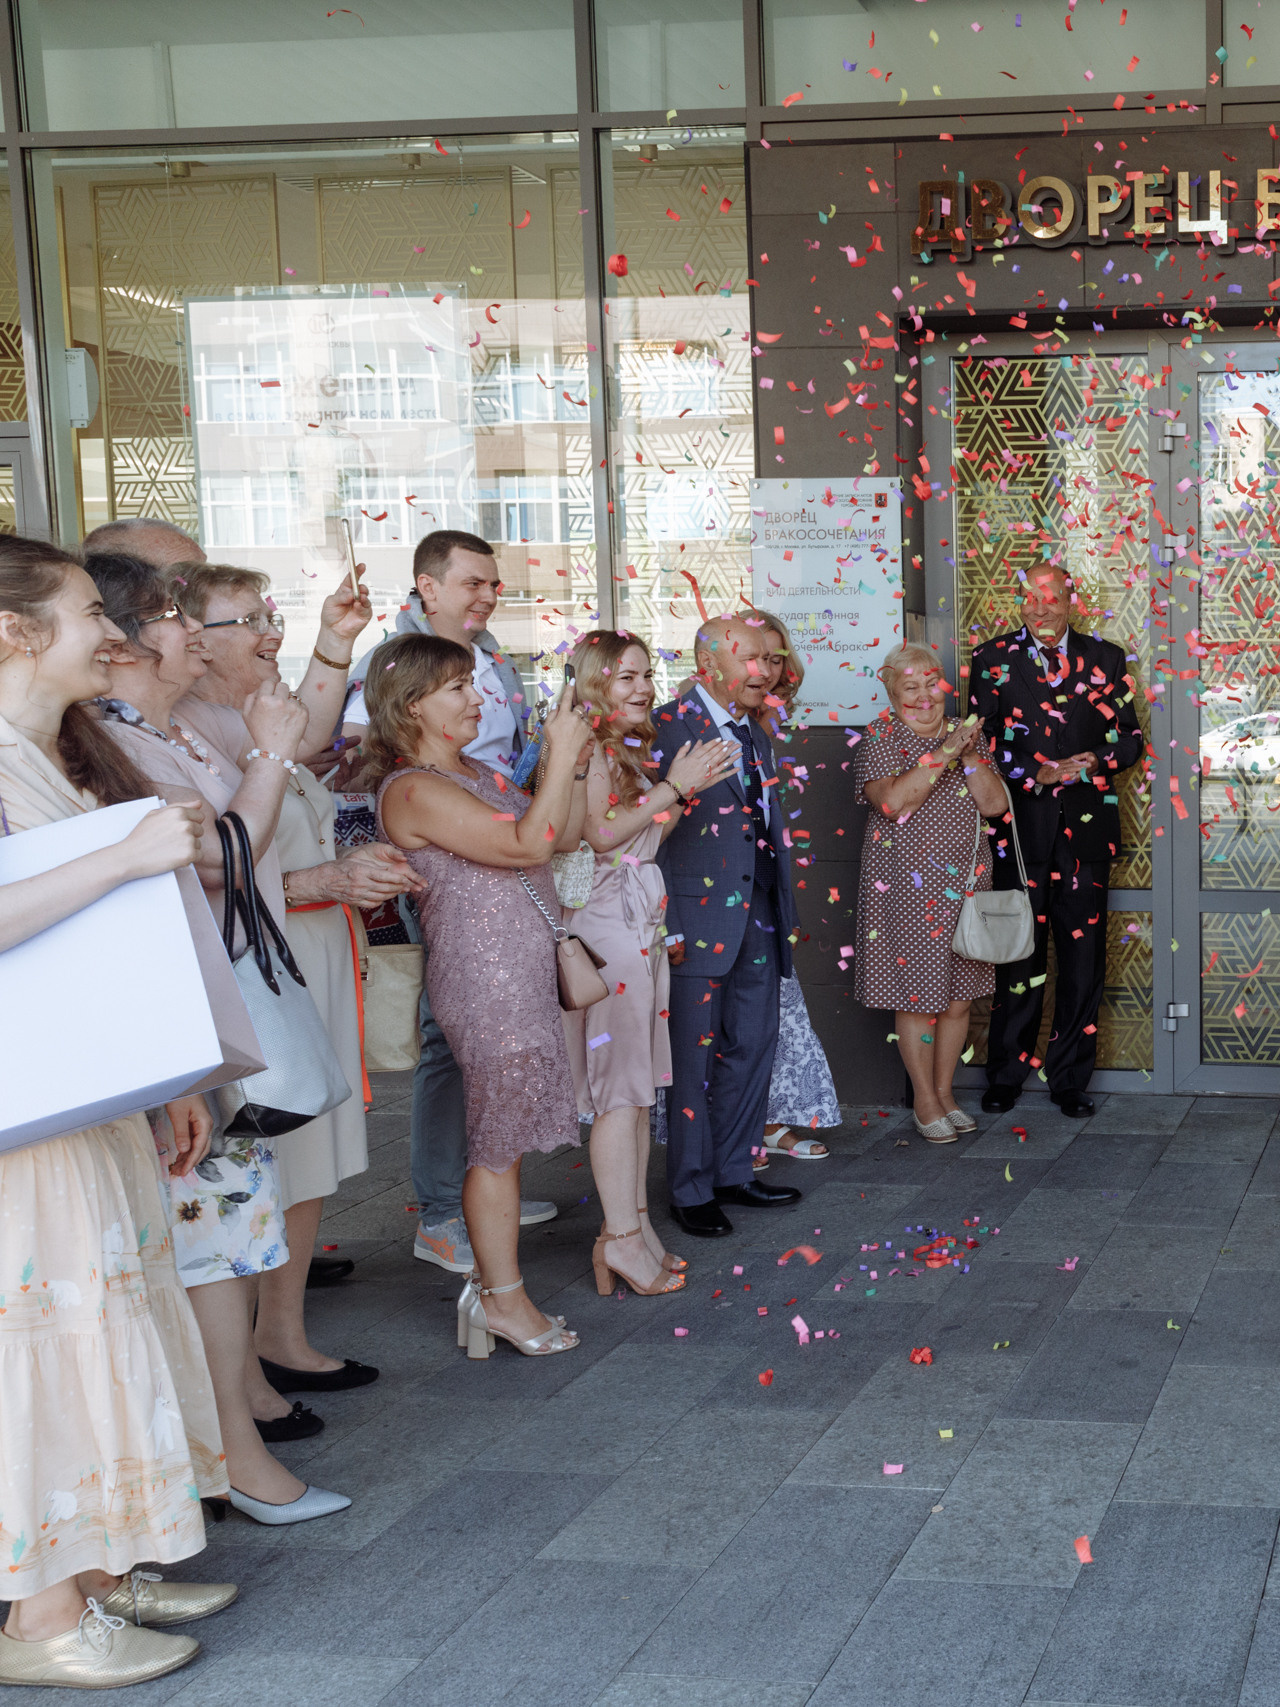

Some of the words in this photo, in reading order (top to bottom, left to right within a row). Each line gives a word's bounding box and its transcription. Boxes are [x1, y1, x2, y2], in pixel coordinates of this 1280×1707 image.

[910, 170, 1229, 255] ДВОРЕЦ
[764, 512, 817, 525] ДВОРЕЦ
[764, 528, 886, 541] БРАКОСОЧЕТАНИЯ
[766, 587, 786, 597] ВИД
[787, 586, 861, 597] ДЕЯТЕЛЬНОСТИ
